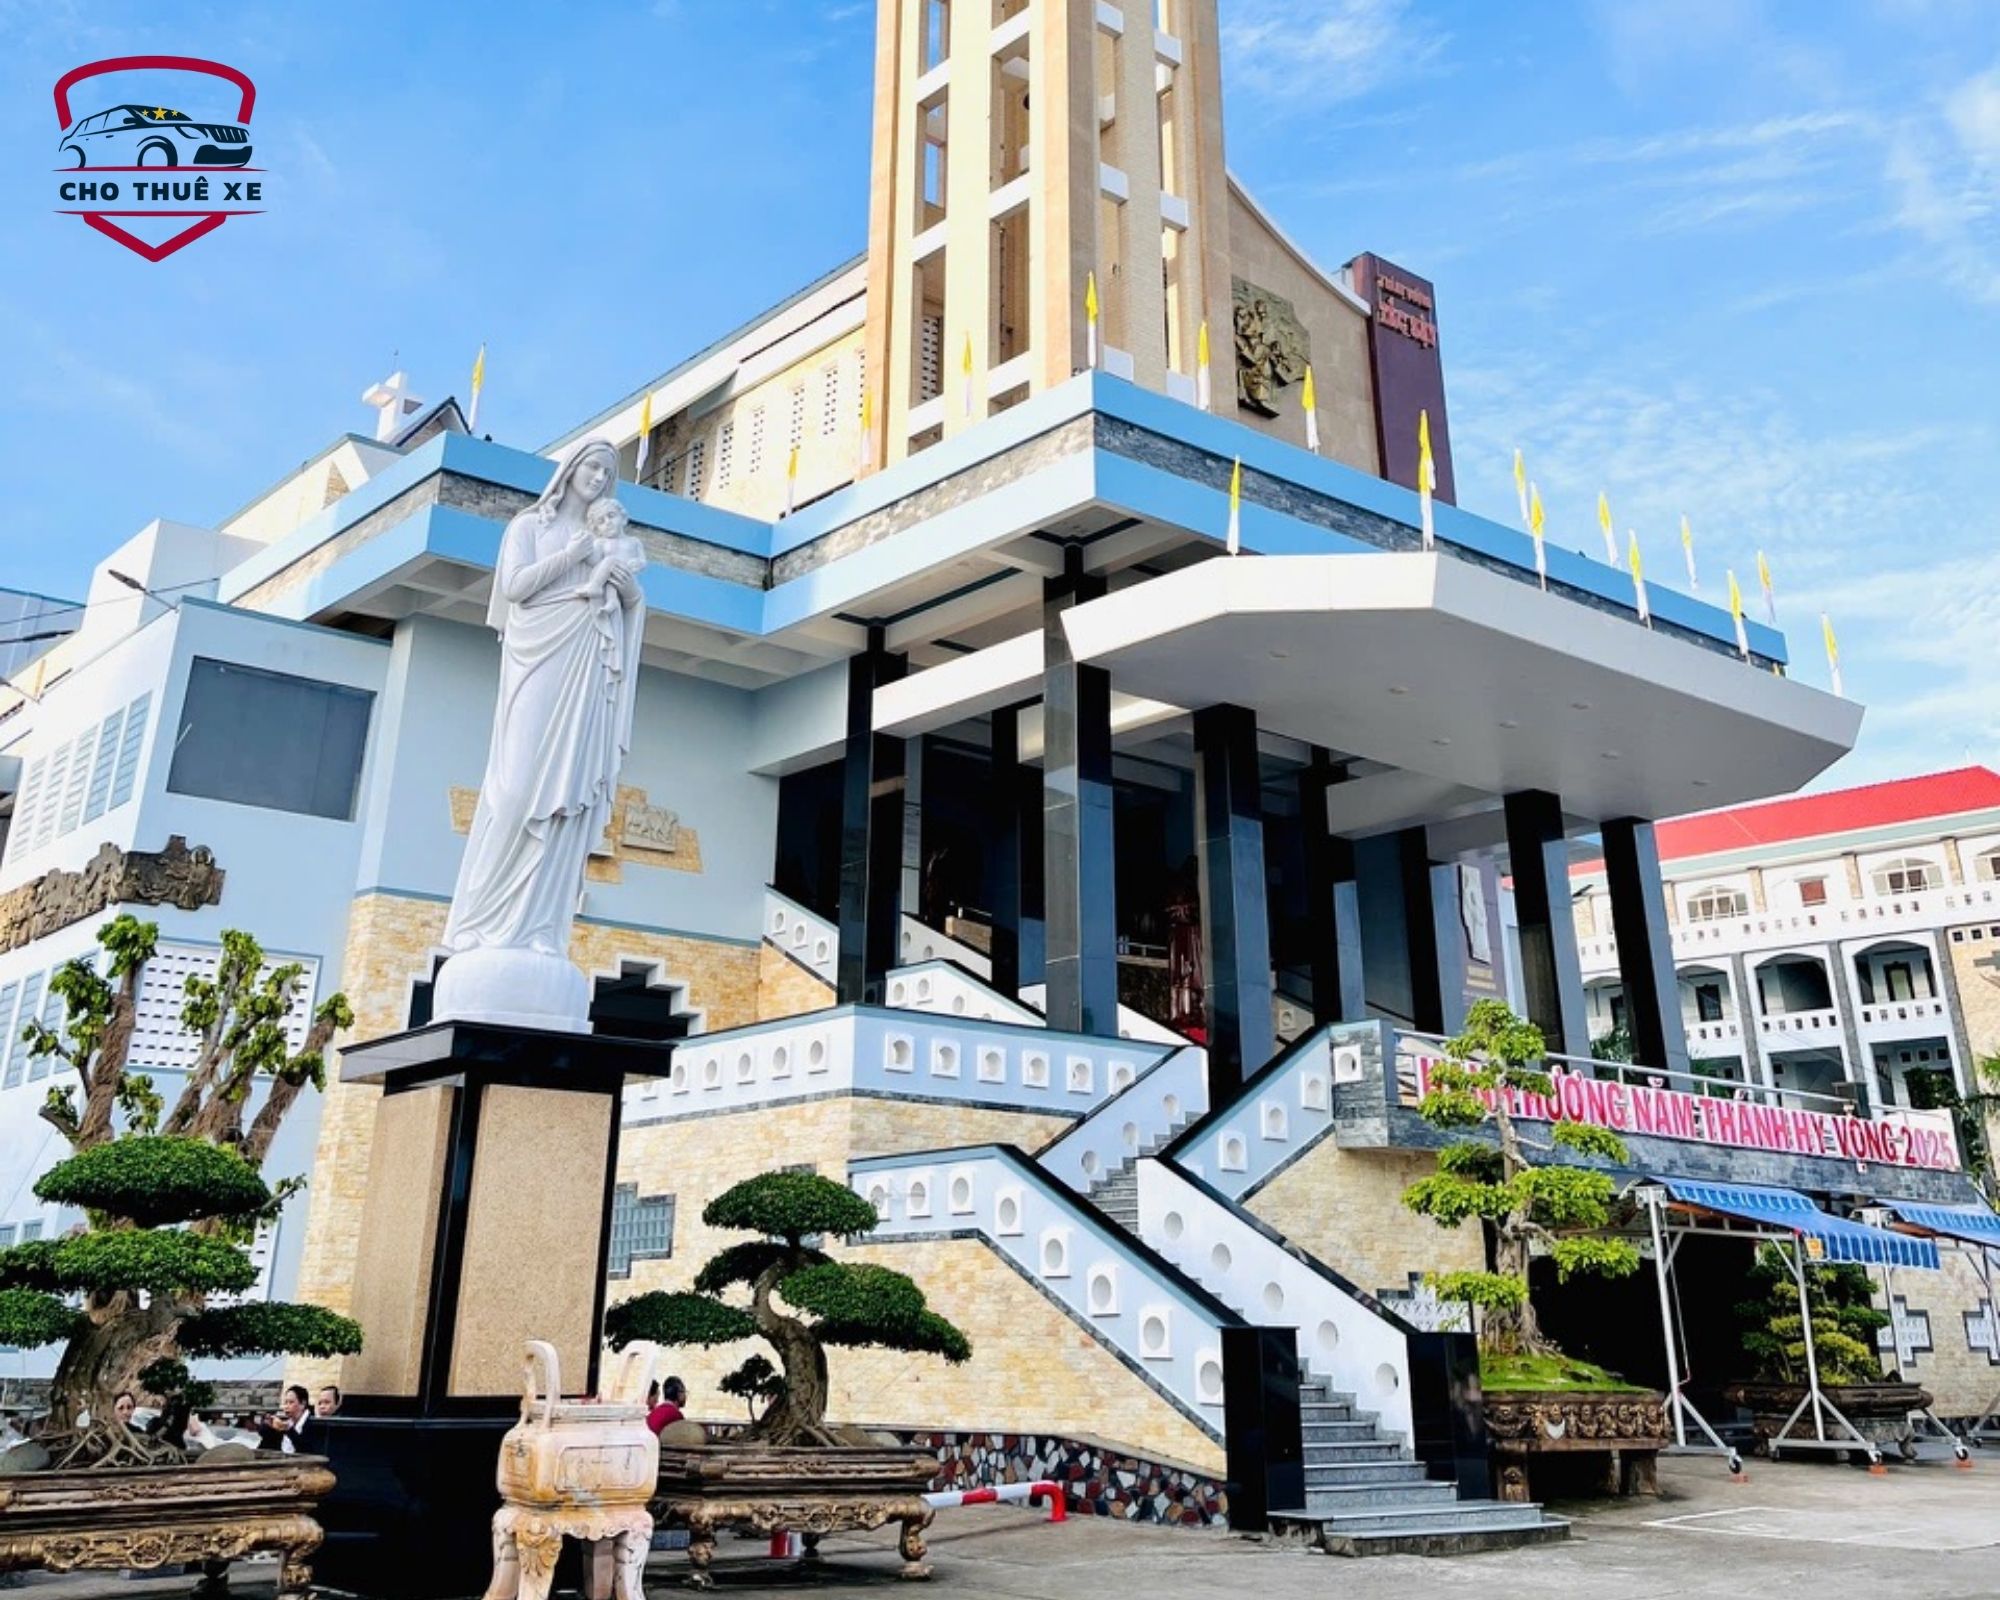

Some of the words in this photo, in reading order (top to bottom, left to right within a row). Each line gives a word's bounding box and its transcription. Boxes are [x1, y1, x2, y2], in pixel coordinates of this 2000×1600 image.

[1632, 1077, 1697, 1137] NĂM
[1700, 1089, 1790, 1147] THÁNH
[1792, 1111, 1826, 1154] HY
[1831, 1116, 1897, 1170] VỌNG
[1900, 1126, 1956, 1168] 2025
